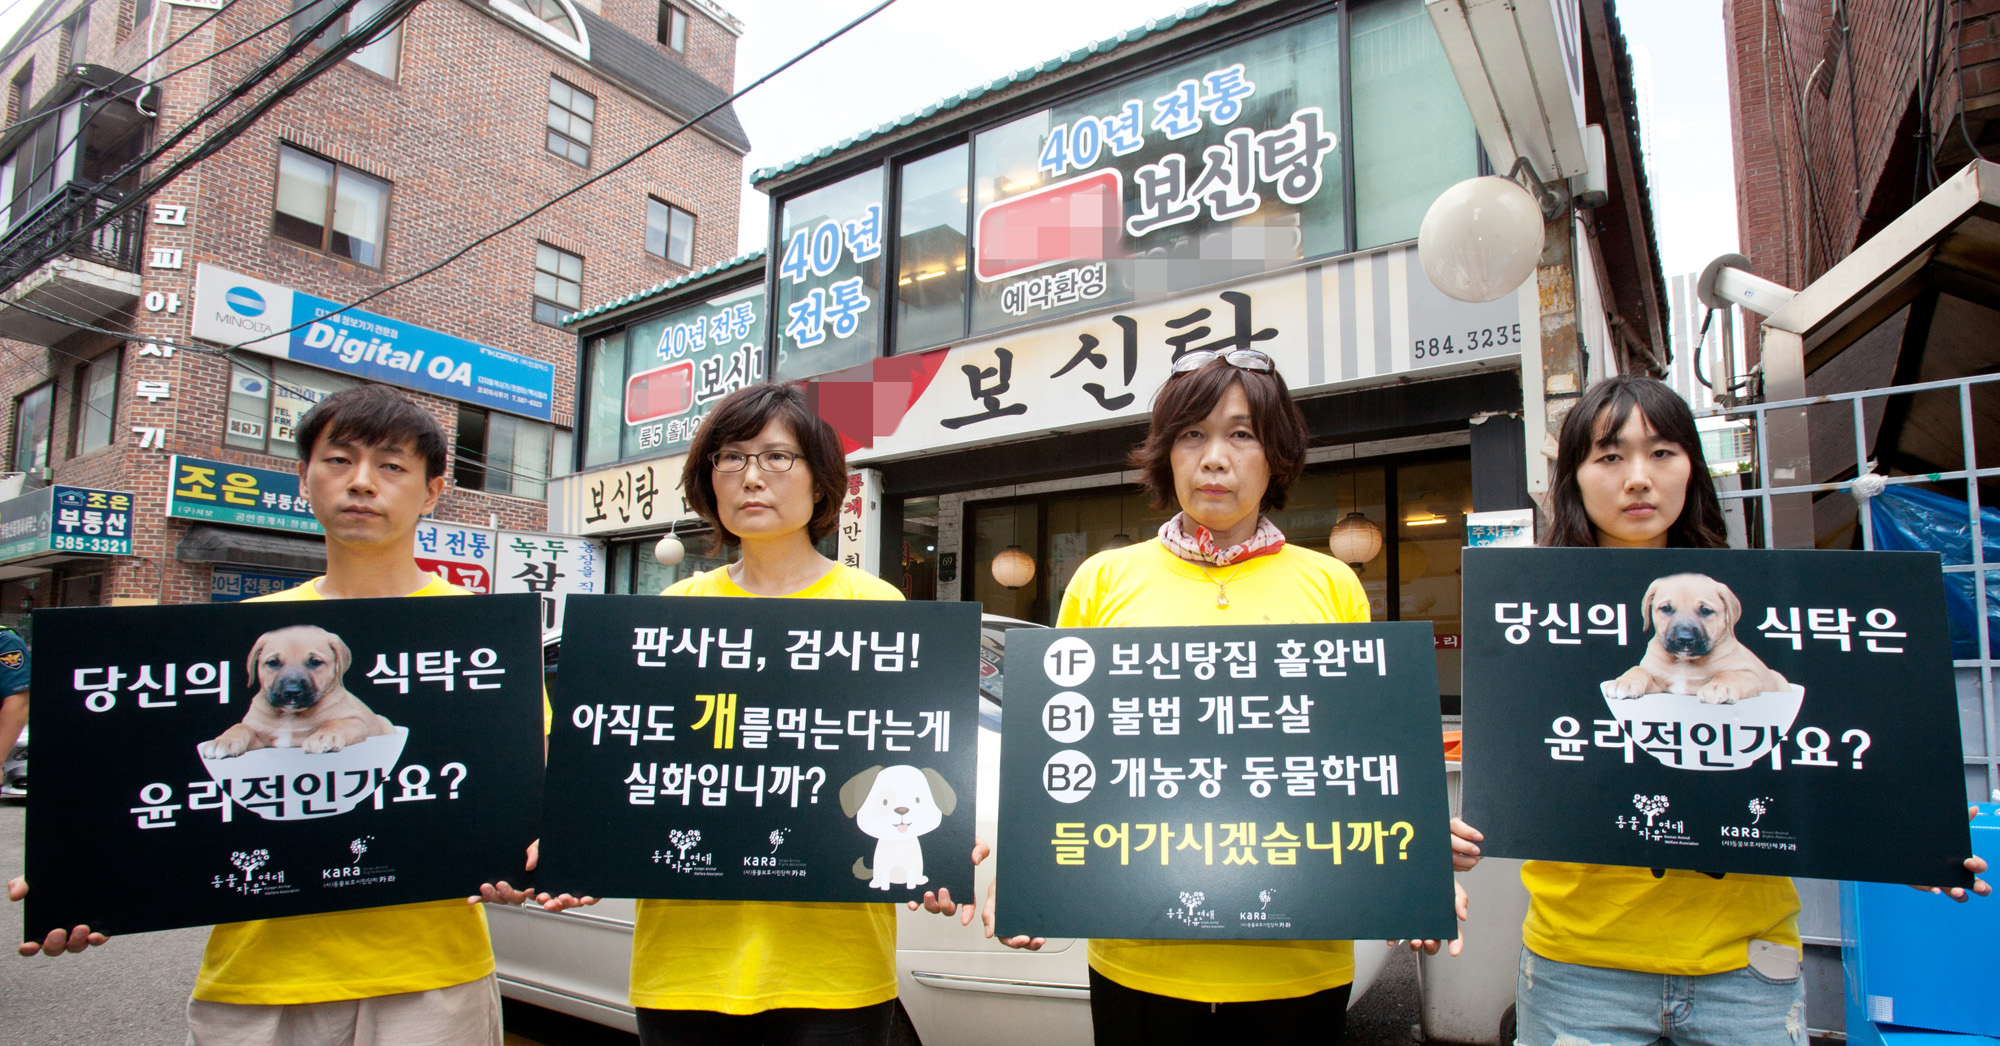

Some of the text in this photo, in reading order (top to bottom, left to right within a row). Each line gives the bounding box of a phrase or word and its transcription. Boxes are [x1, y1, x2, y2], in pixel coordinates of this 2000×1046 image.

[1040, 63, 1256, 173] 40년 전통
[1126, 106, 1336, 237] 보신탕
[780, 202, 882, 286] 40년
[1003, 262, 1108, 316] 예약환영
[215, 311, 273, 334] MINOLTA
[657, 301, 756, 361] 40년 전통
[785, 277, 871, 349] 전통
[303, 321, 472, 387] Digital OA
[1415, 324, 1520, 359] 584.3235
[275, 407, 291, 417] TEL
[640, 425, 662, 449] 룸5
[87, 492, 130, 511] 조은
[176, 464, 314, 515] 조은 부동산
[585, 466, 659, 524] 보신탕
[55, 535, 127, 553] 585-3321
[58, 508, 126, 536] 부동산
[445, 530, 490, 559] 전통
[510, 538, 569, 561] 녹두
[632, 626, 920, 672] 판사님, 검사님!
[1494, 601, 1907, 653] 당신의 식탁은
[73, 647, 506, 713] 당신의 식탁은
[1049, 650, 1088, 677] 1F
[1108, 640, 1258, 681] 보신탕집
[1273, 638, 1388, 678] 홀완비
[572, 693, 950, 752] 아직도 개를먹는다는게
[1048, 694, 1314, 736] B1 불법 개도살
[1544, 715, 1871, 770] 윤리적인가요?
[130, 762, 467, 830] 윤리적인가요?
[623, 762, 826, 808] 실화입니까?
[1047, 754, 1399, 799] B2 개농장 동물학대
[1050, 820, 1415, 866] 들어가시겠습니까?
[1779, 842, 1797, 851] 카라
